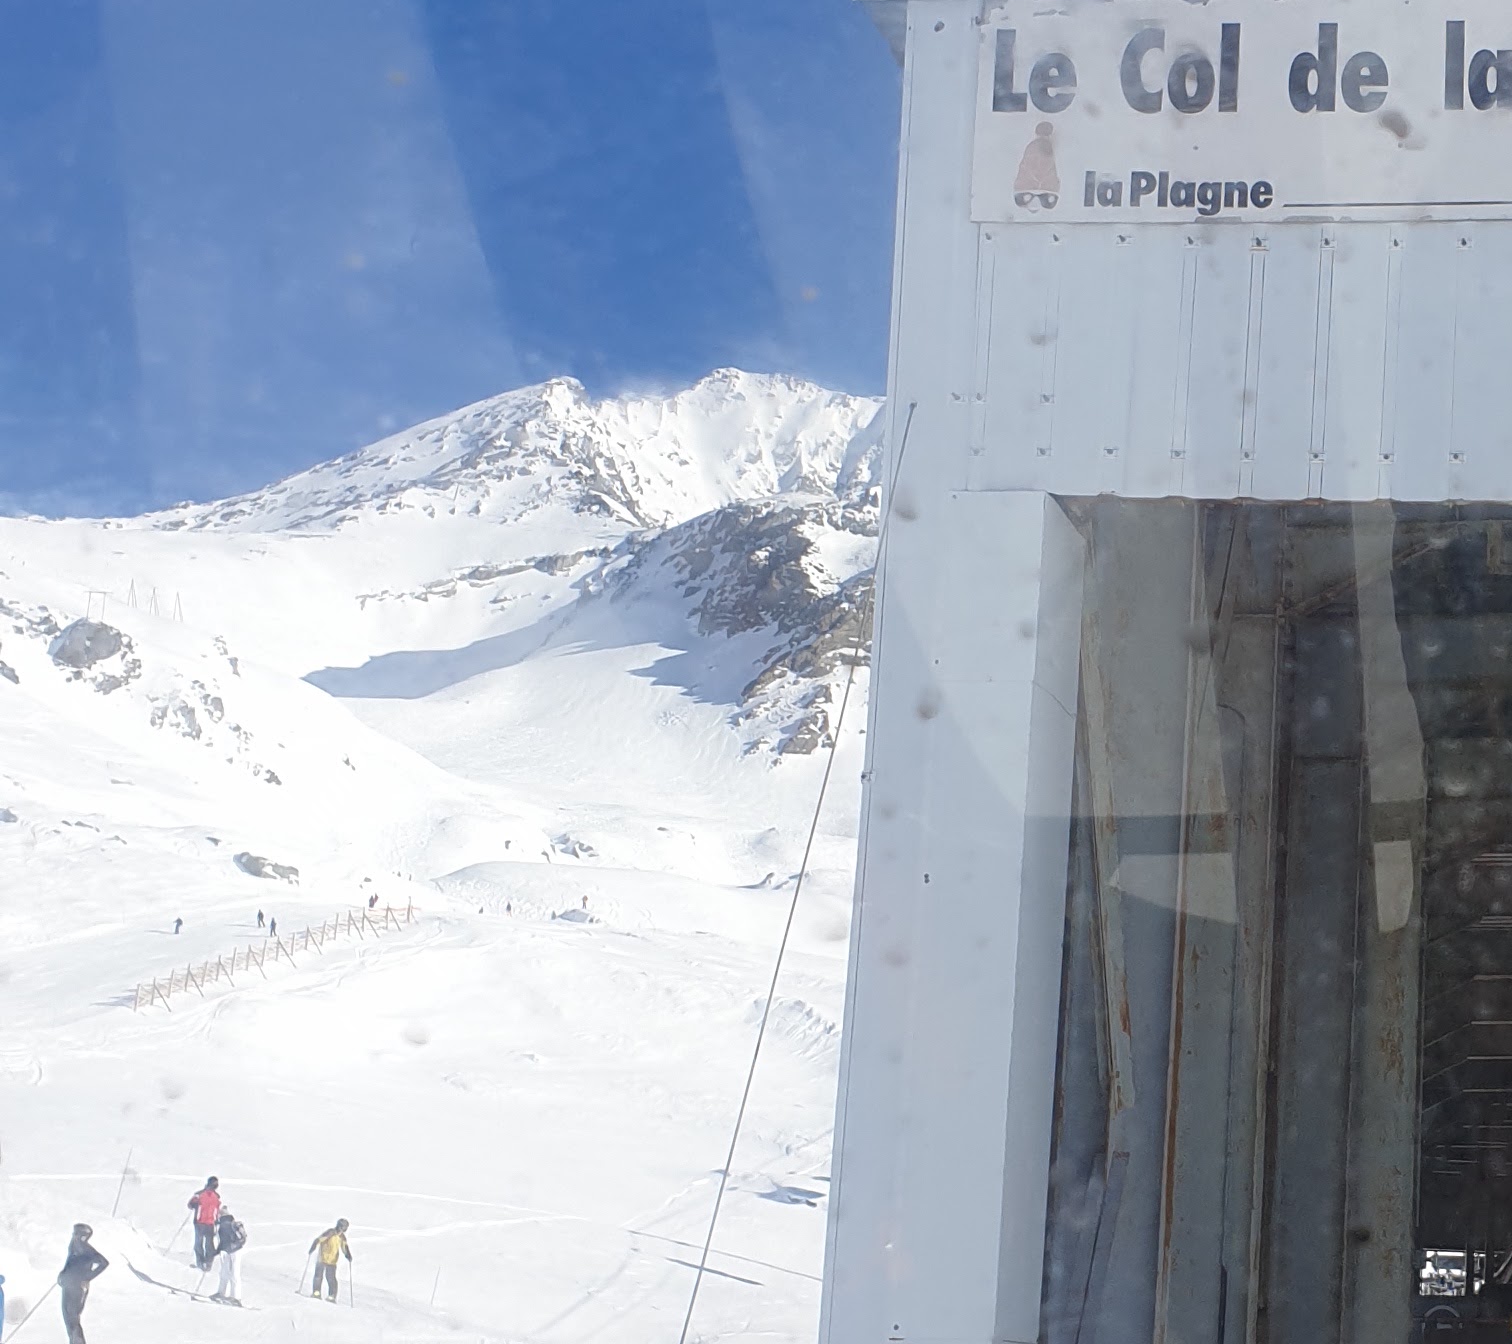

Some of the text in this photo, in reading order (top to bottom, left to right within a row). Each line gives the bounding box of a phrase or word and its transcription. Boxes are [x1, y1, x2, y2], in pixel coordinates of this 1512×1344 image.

[992, 28, 1078, 114] Le
[1119, 22, 1241, 115] Col
[1287, 22, 1390, 114] de
[1083, 170, 1274, 216] la Plagne
